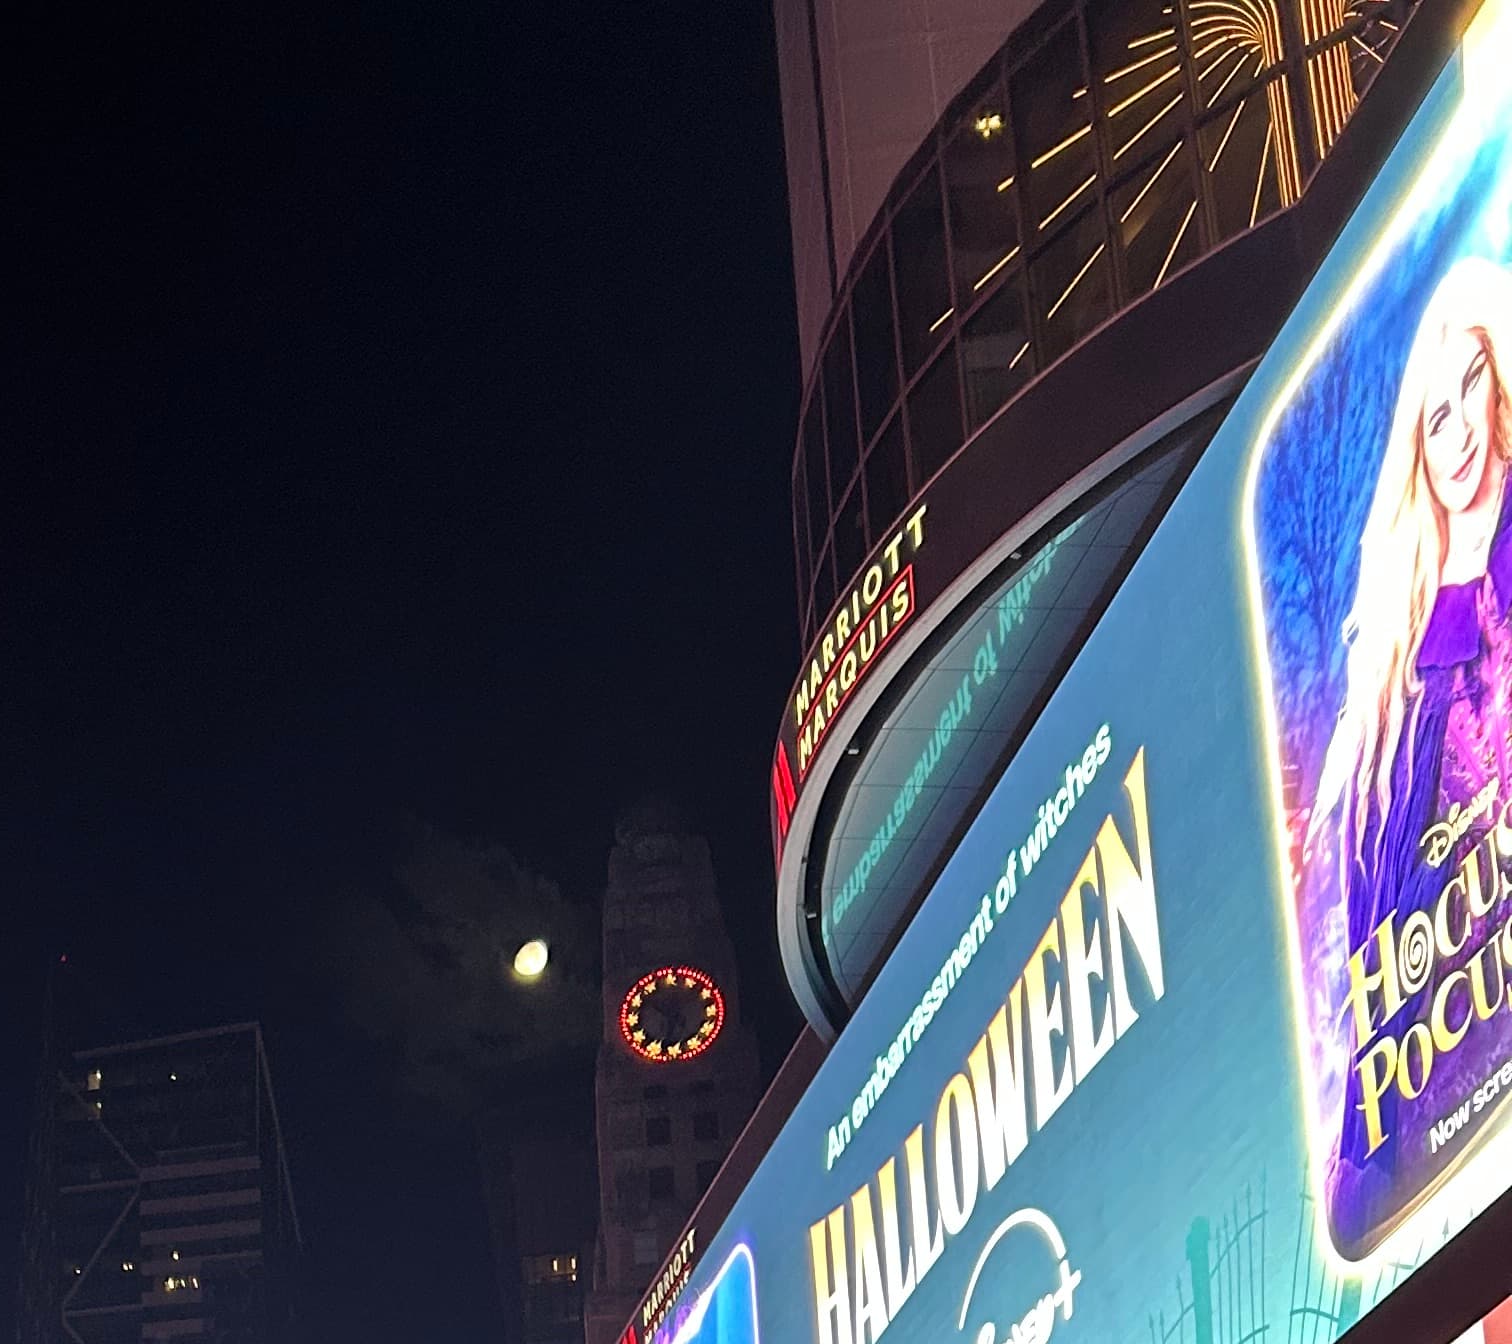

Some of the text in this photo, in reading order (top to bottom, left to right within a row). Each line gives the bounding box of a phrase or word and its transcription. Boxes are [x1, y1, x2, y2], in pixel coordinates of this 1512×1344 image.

[795, 504, 928, 723] MARRIOTT
[798, 580, 910, 771] MARQUIS
[826, 722, 1113, 1171] An embarrassment of witches
[1429, 1099, 1471, 1154] Now
[643, 1227, 697, 1327] MARRIOTT
